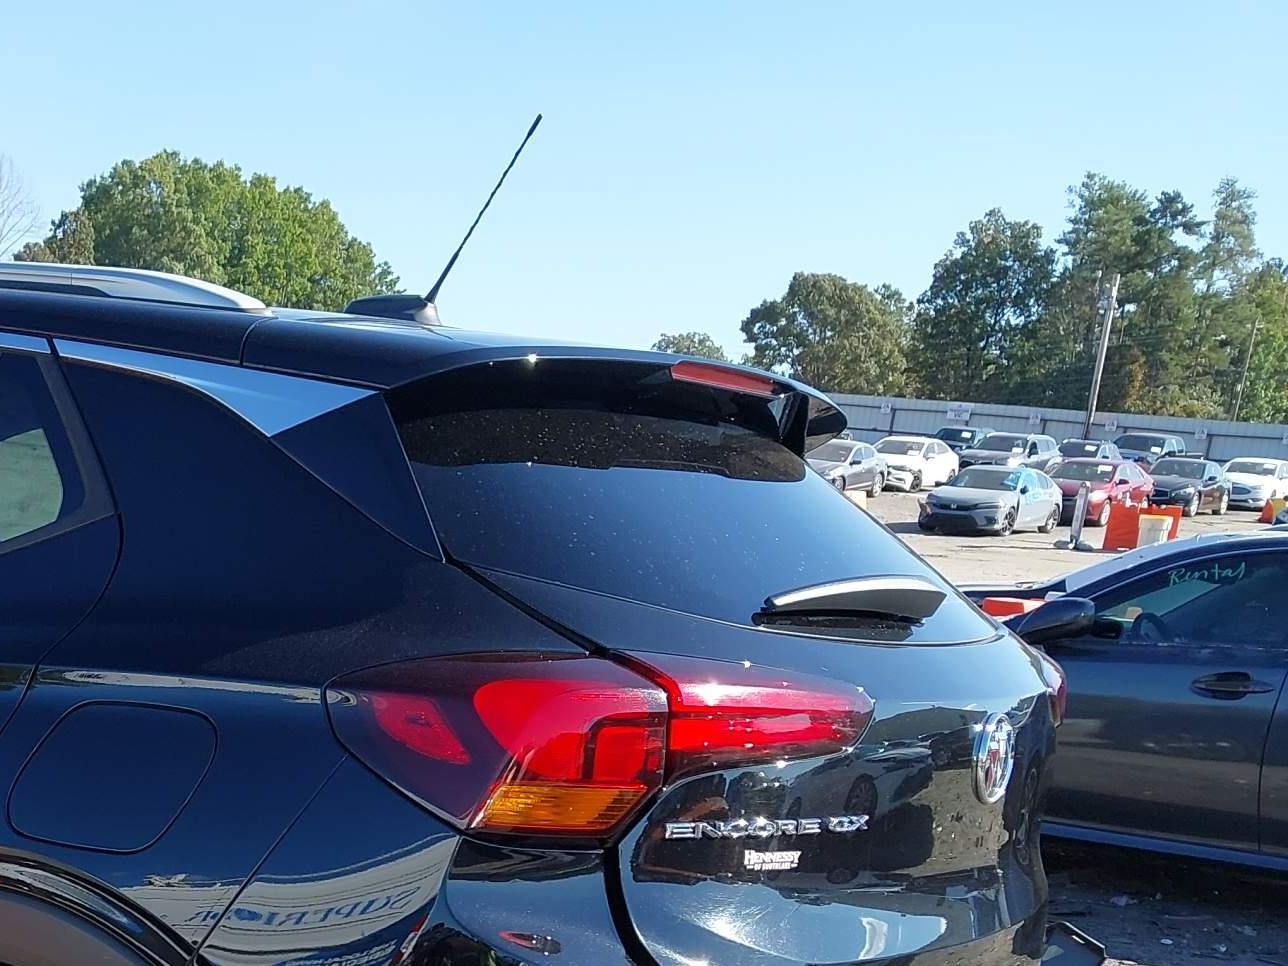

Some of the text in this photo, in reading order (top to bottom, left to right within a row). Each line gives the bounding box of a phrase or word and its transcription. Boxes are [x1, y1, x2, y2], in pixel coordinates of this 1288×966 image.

[1168, 561, 1247, 588] Rental
[665, 814, 870, 840] ENCORE GX
[744, 849, 802, 865] HENNESSY
